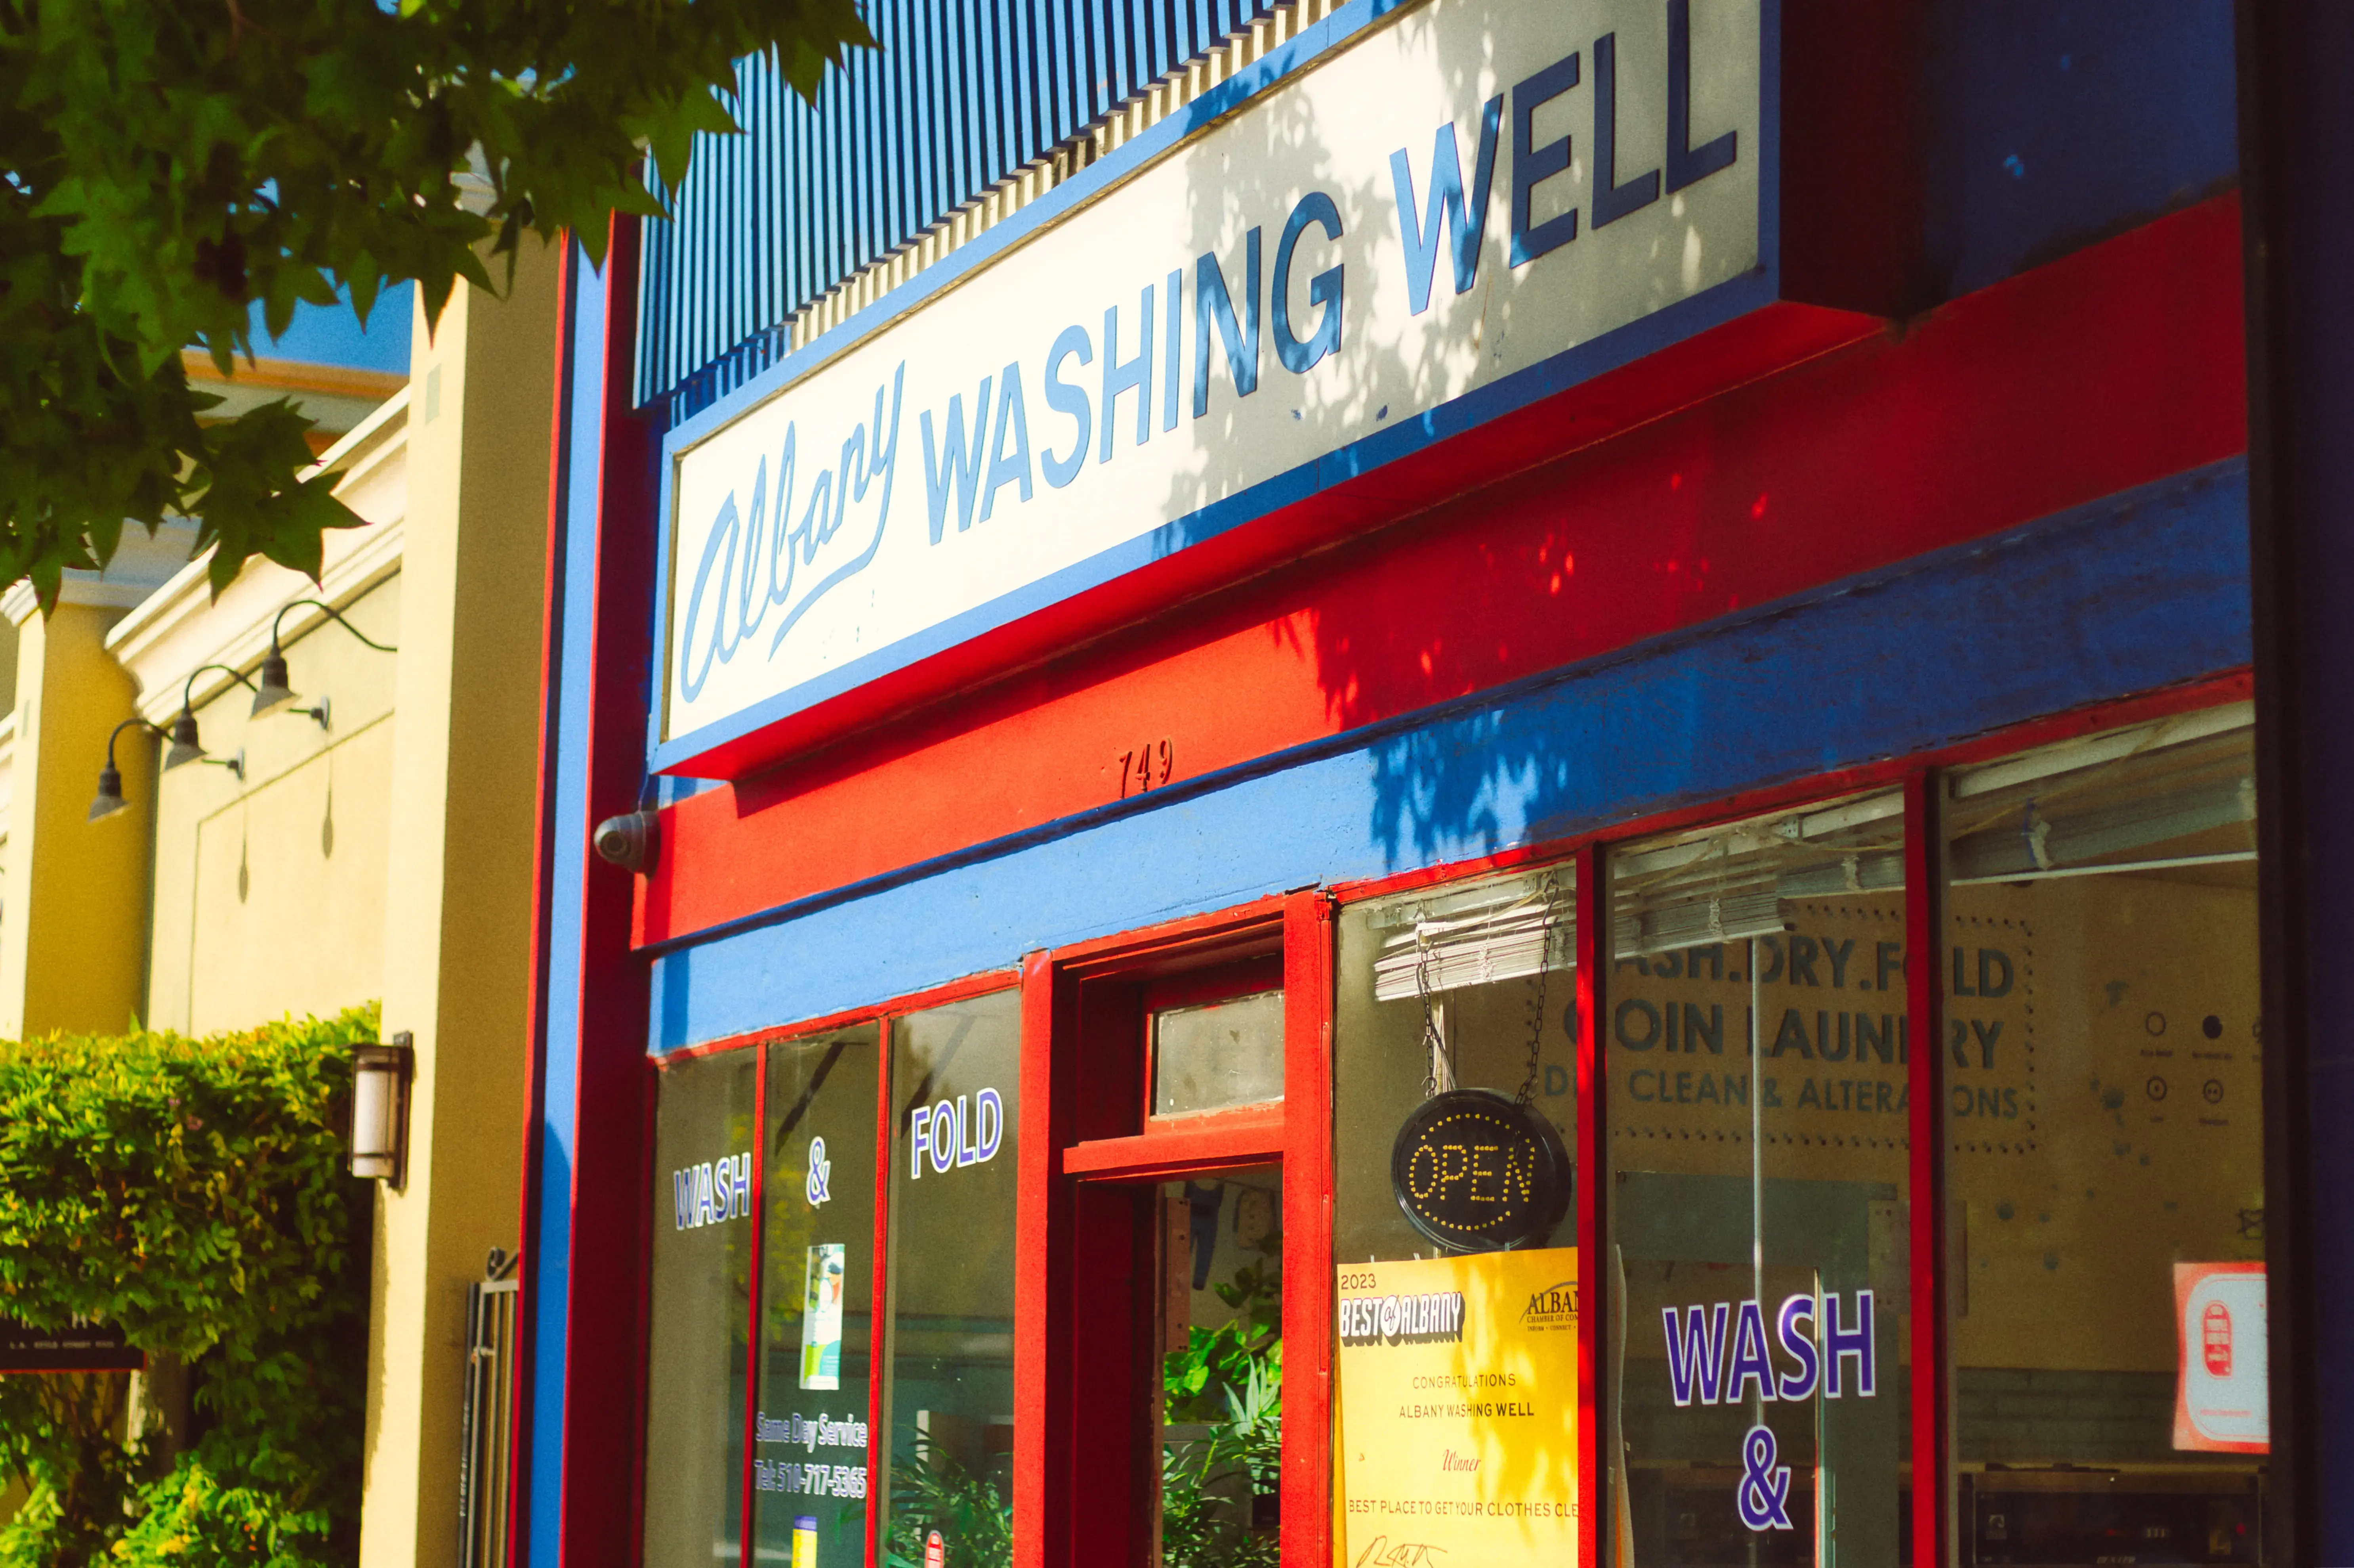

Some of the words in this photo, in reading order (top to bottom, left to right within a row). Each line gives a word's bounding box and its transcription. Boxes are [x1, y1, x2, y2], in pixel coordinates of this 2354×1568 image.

[681, 359, 905, 704] Albany
[919, 191, 1344, 546] WASHING
[1389, 0, 1737, 317] WELL
[1119, 736, 1173, 799] 749
[1747, 1005, 2004, 1069] LAUNRY
[1628, 1069, 1748, 1106] CLEAN
[1763, 1077, 1782, 1108] &
[673, 1152, 751, 1231] WASH
[806, 1136, 831, 1206] &
[910, 1087, 1003, 1180] FOLD
[1409, 1144, 1536, 1203] OPEN
[1341, 1273, 1376, 1290] 2023
[1340, 1297, 1383, 1341] BEST
[1400, 1291, 1463, 1339] ALBANY
[1527, 1315, 1554, 1323] CHAMBER
[1662, 1289, 1876, 1407] WASH
[1412, 1373, 1516, 1389] CONGRATULATIONS
[755, 1411, 790, 1443] Same
[791, 1412, 818, 1454] Day
[817, 1413, 868, 1448] Service
[1399, 1404, 1444, 1418] ALBANY
[1446, 1403, 1492, 1417] WASHING
[1496, 1402, 1535, 1417] WELL
[1442, 1449, 1481, 1472] Winner
[1737, 1425, 1794, 1531] &
[1349, 1499, 1376, 1513] BEST
[1381, 1500, 1416, 1515] PLACE
[1418, 1501, 1432, 1515] TO
[1435, 1501, 1454, 1515] GET
[1455, 1501, 1483, 1516] YOUR
[1487, 1502, 1551, 1517] CLOTHES
